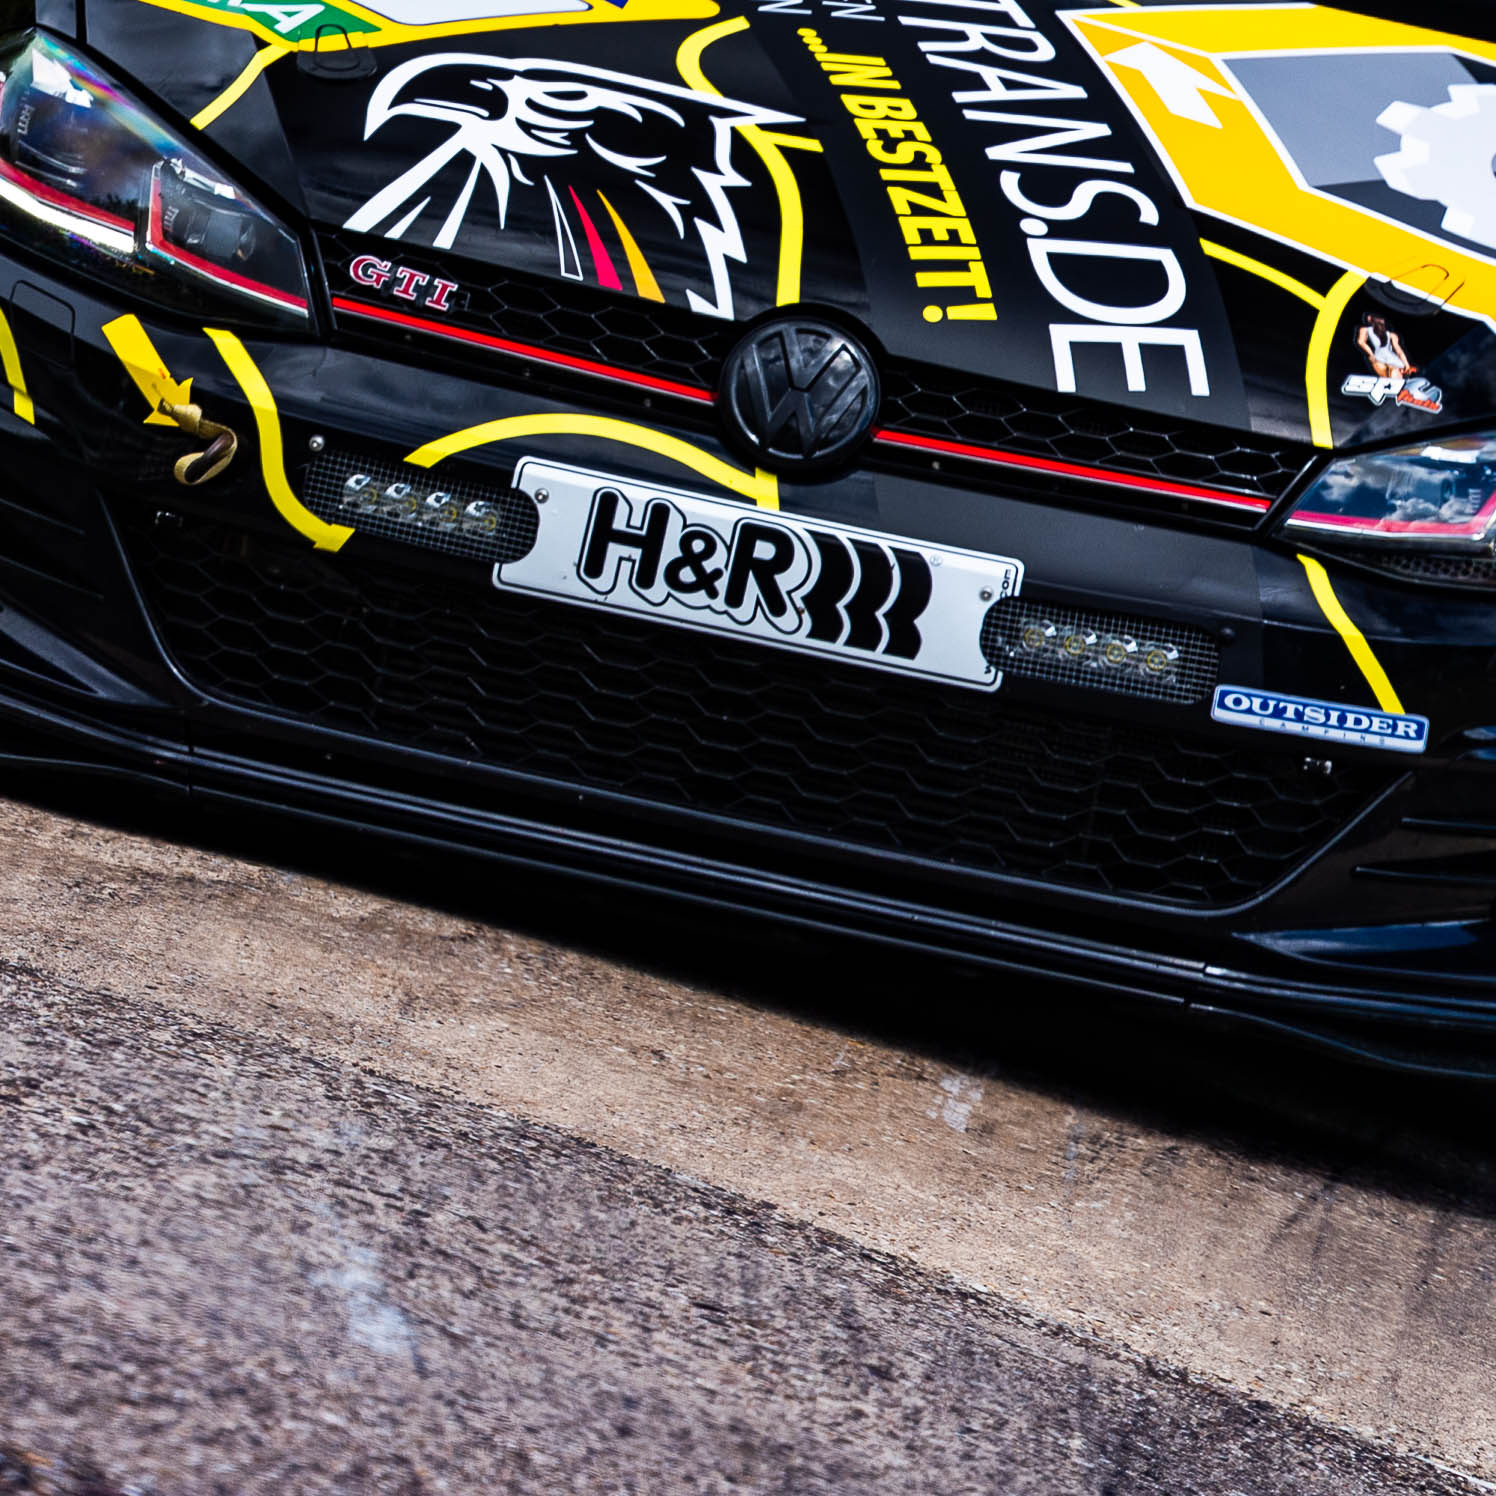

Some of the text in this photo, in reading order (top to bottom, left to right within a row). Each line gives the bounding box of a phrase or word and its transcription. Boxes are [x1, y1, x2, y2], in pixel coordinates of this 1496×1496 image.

[839, 93, 998, 324] BESTZEIT!
[349, 255, 459, 312] GTI
[580, 488, 802, 626] H&R
[1223, 693, 1418, 739] OUTSIDER
